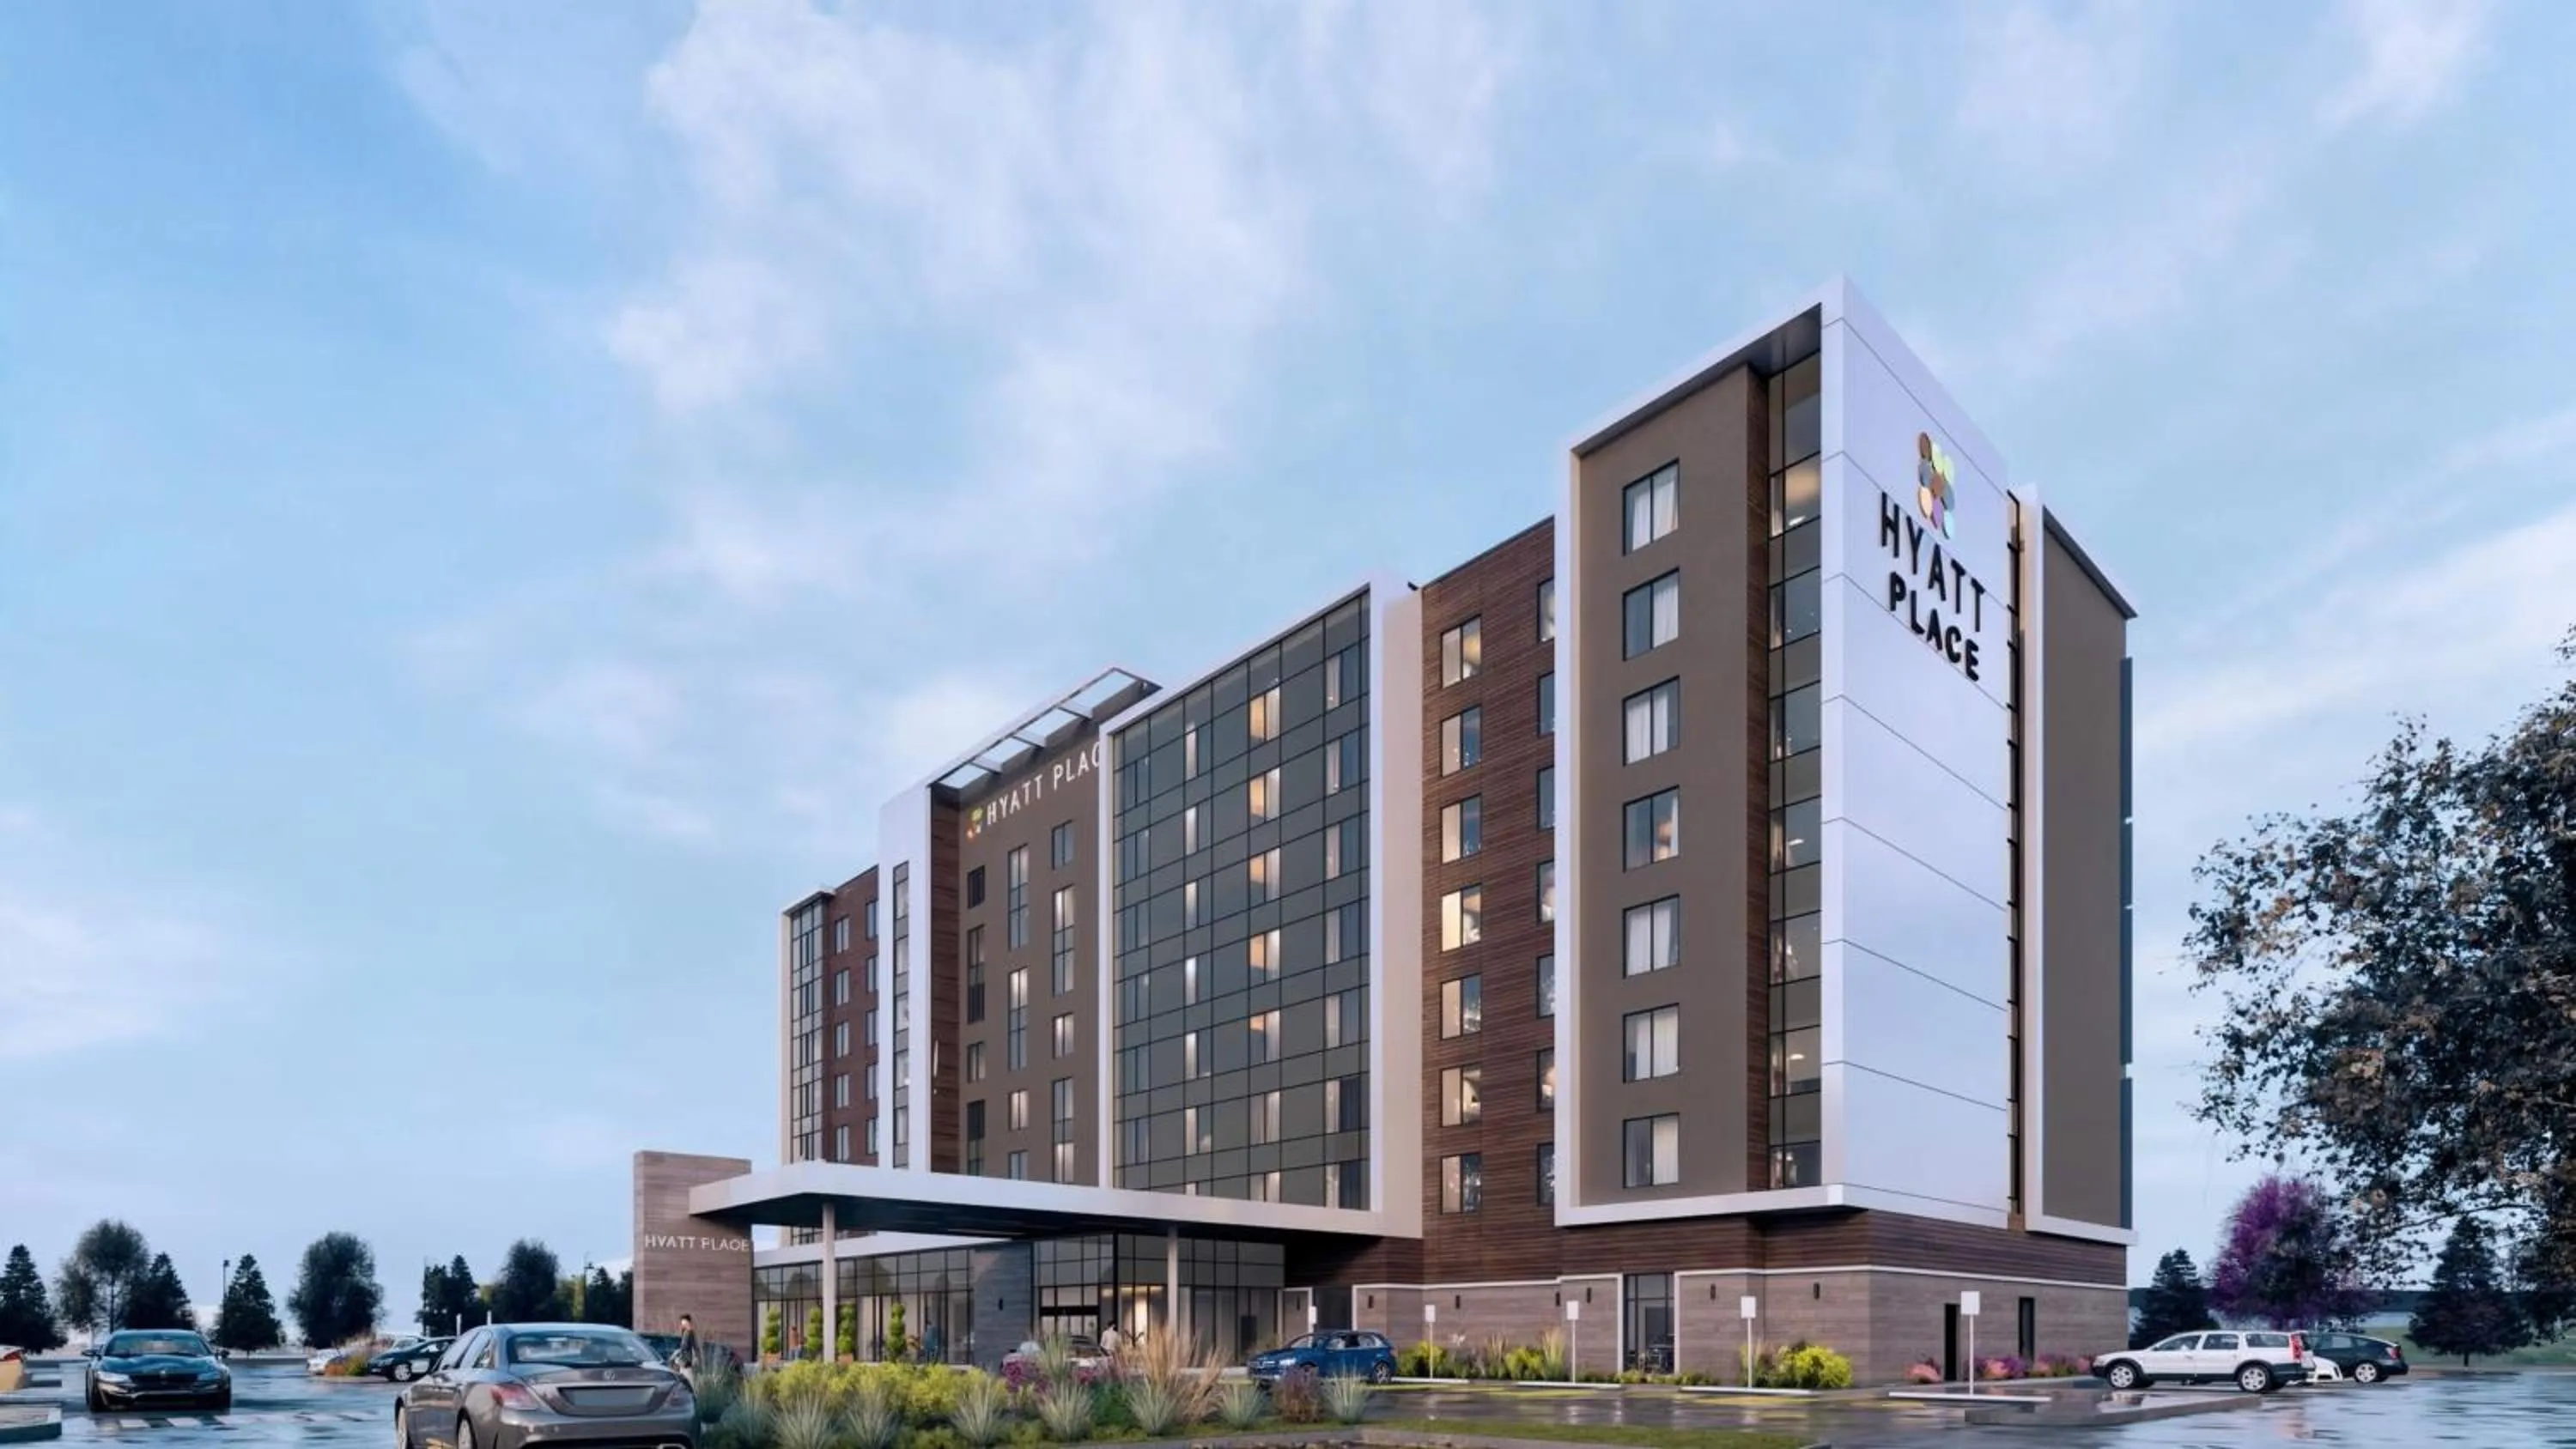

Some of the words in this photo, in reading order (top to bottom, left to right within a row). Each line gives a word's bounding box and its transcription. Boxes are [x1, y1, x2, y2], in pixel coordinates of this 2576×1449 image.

[1880, 491, 1985, 632] HYATT
[1889, 572, 1979, 682] PLACE
[987, 774, 1043, 825] HYATT
[1053, 741, 1100, 791] PLAC
